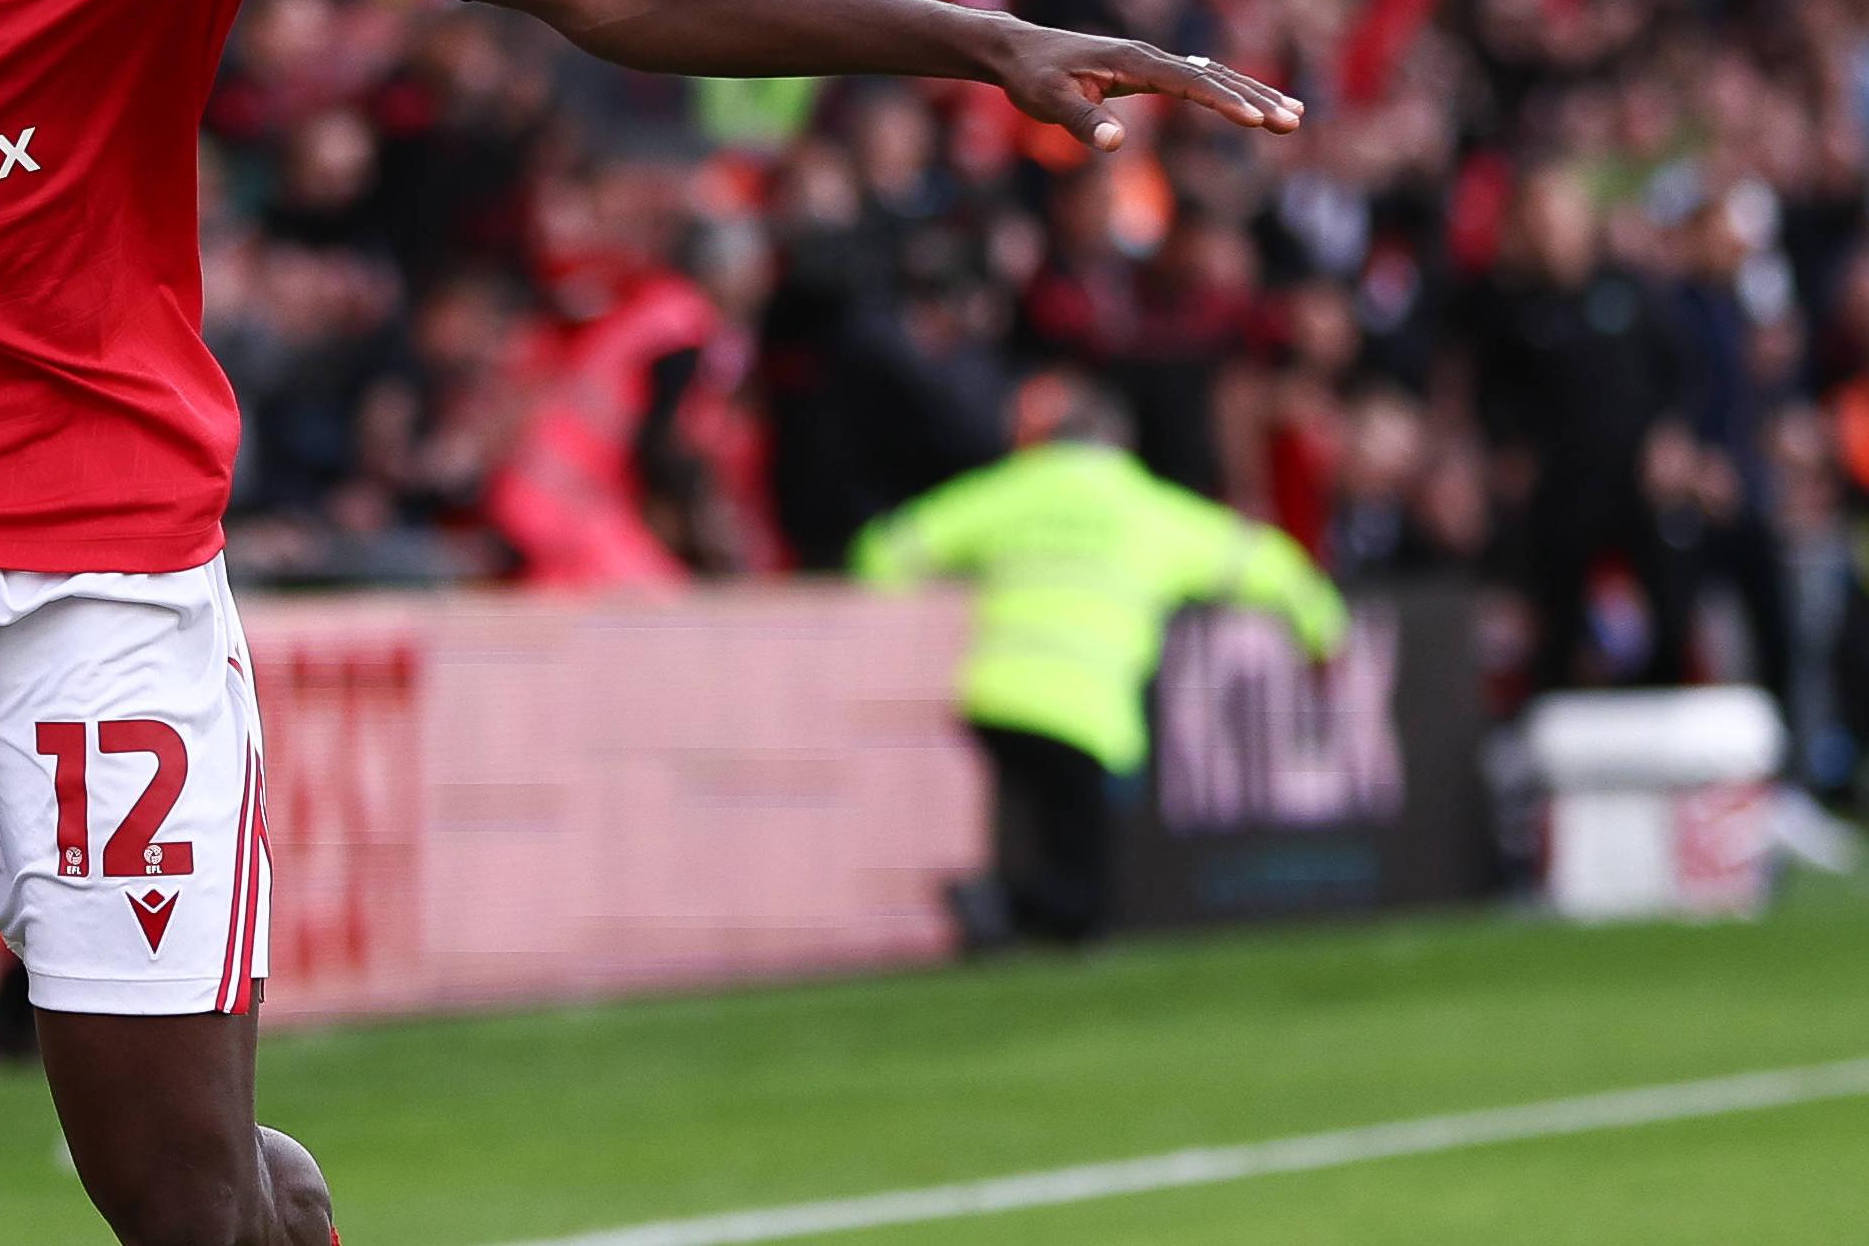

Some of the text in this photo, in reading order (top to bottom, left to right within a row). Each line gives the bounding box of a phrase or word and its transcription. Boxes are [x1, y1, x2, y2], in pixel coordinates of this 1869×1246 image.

[34, 719, 194, 877] 12
[66, 865, 82, 875] EFL
[145, 865, 162, 874] EFL
